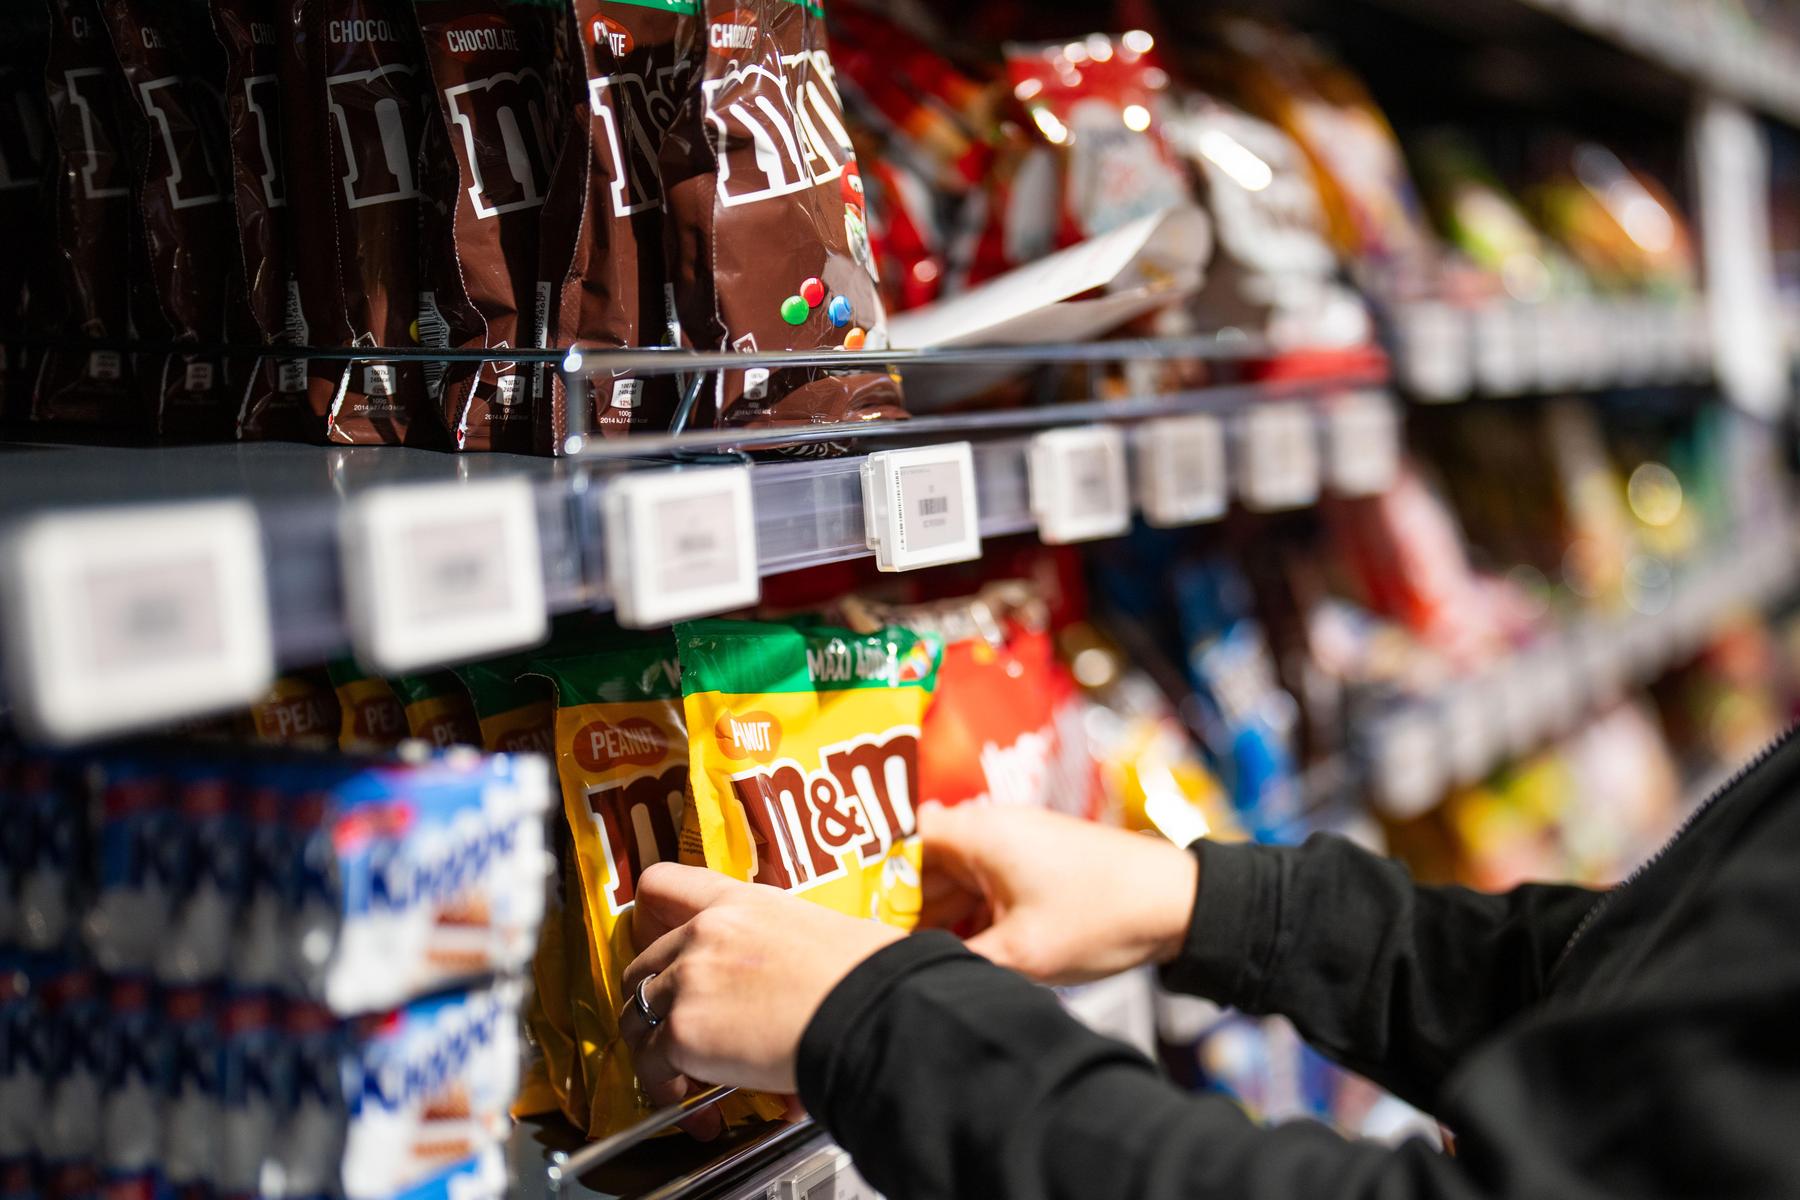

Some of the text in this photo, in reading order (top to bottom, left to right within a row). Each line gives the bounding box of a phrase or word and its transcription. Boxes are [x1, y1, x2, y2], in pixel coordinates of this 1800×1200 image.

[447, 28, 522, 53] CHOCOLATE
[618, 410, 632, 418] 100g
[590, 727, 663, 761] PEANUT
